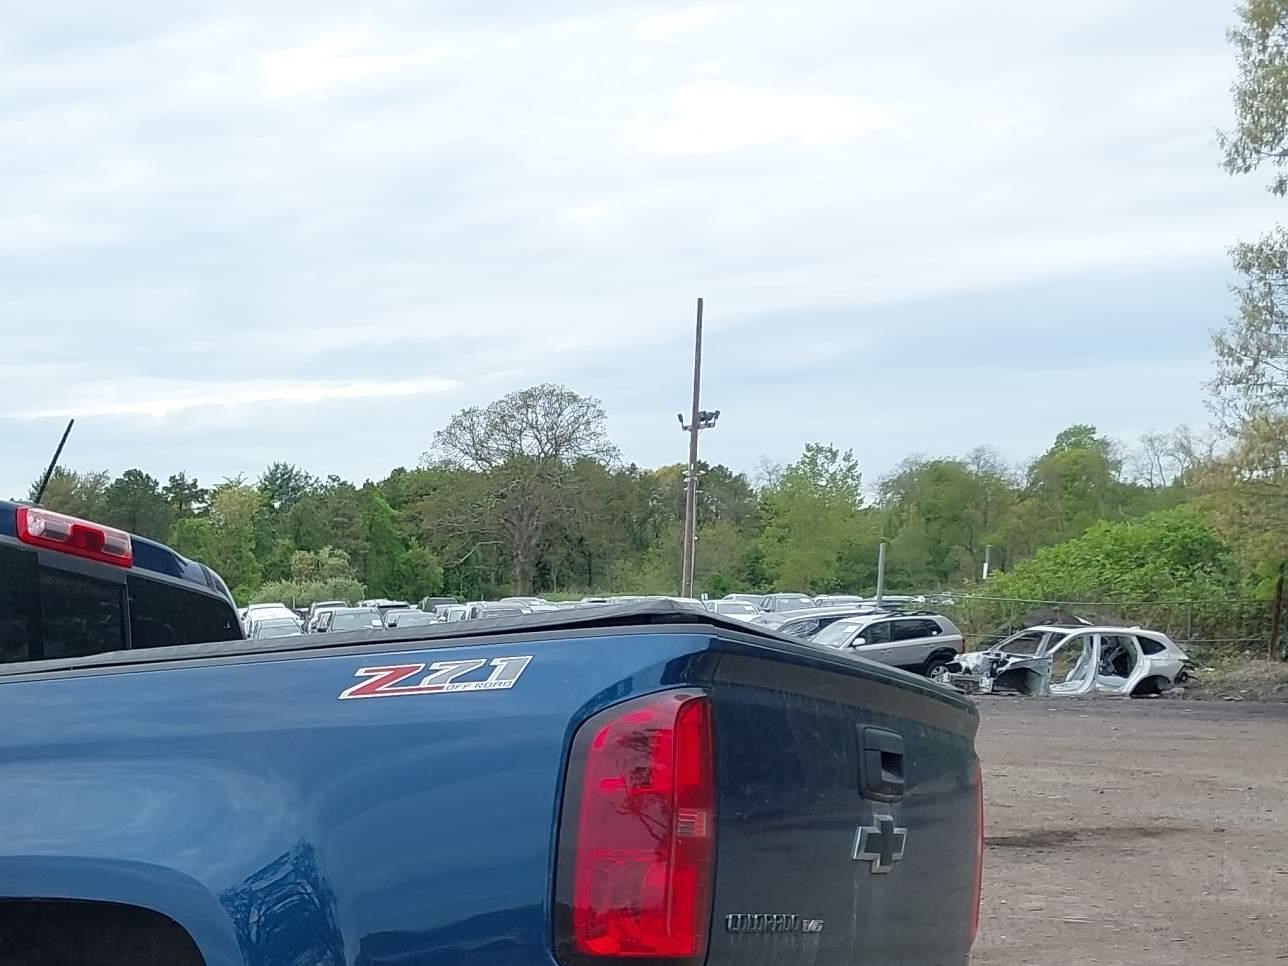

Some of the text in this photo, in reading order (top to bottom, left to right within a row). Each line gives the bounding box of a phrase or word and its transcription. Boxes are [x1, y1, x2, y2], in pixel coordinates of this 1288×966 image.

[337, 655, 535, 700] Z71
[446, 680, 513, 691] OFF ROAD
[802, 919, 824, 932] V6
